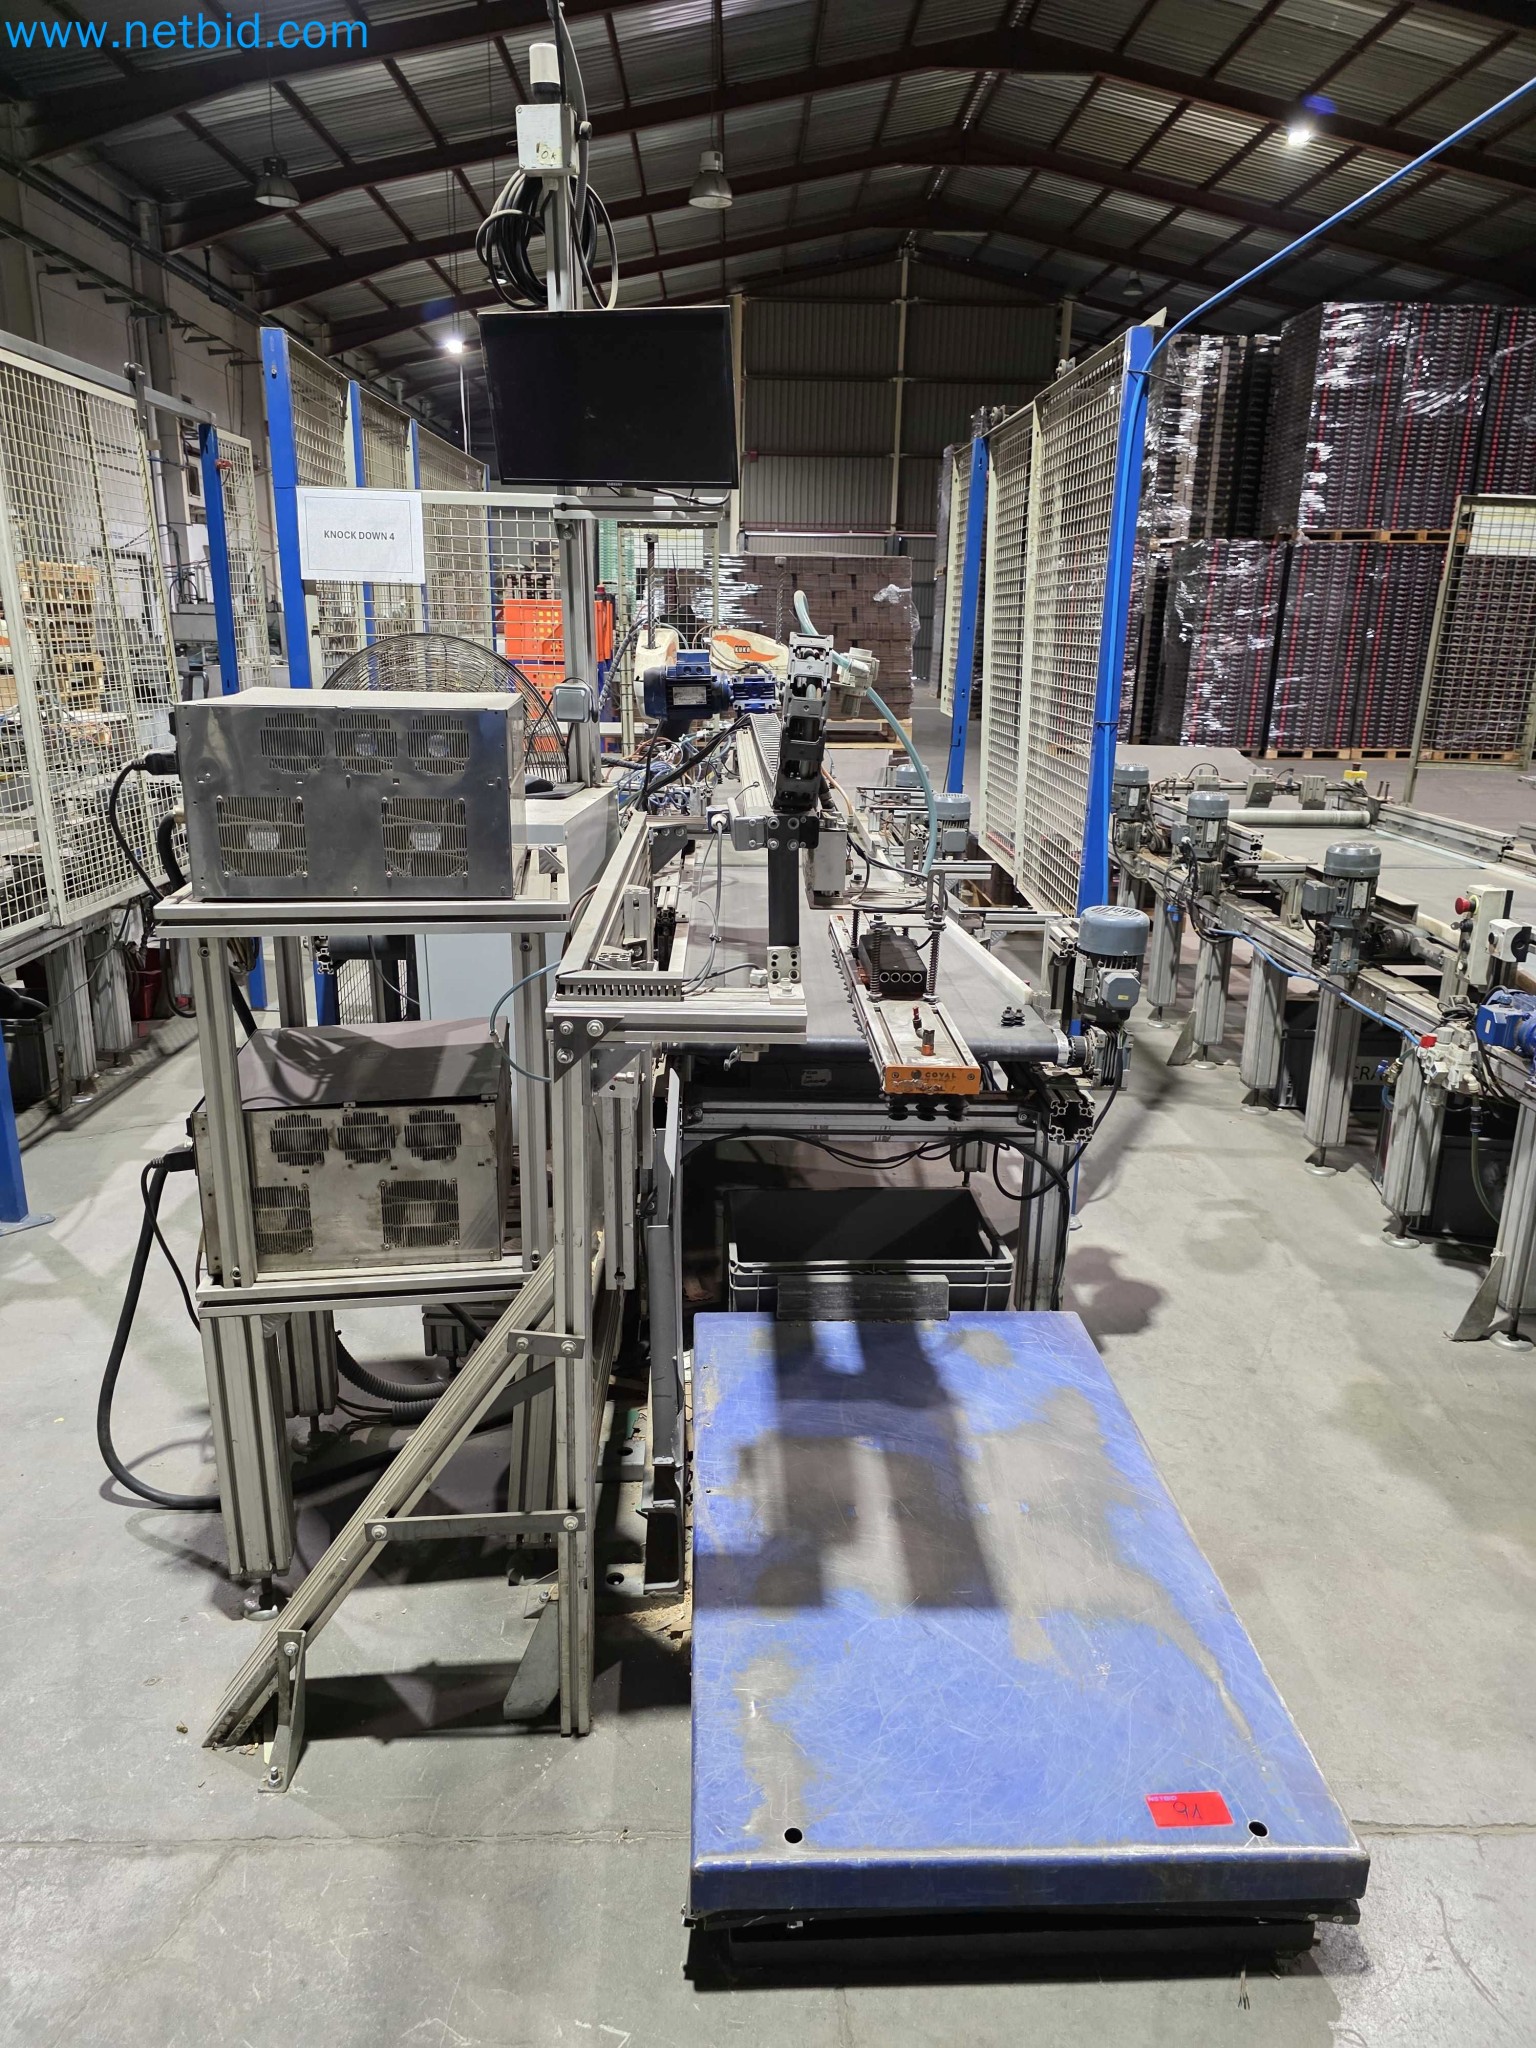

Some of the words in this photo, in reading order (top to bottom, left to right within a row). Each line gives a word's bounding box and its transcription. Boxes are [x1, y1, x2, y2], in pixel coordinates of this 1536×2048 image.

[324, 530, 357, 540] KNOCK
[358, 531, 388, 541] DOWN
[389, 532, 395, 541] 4
[925, 1071, 957, 1079] COVAL
